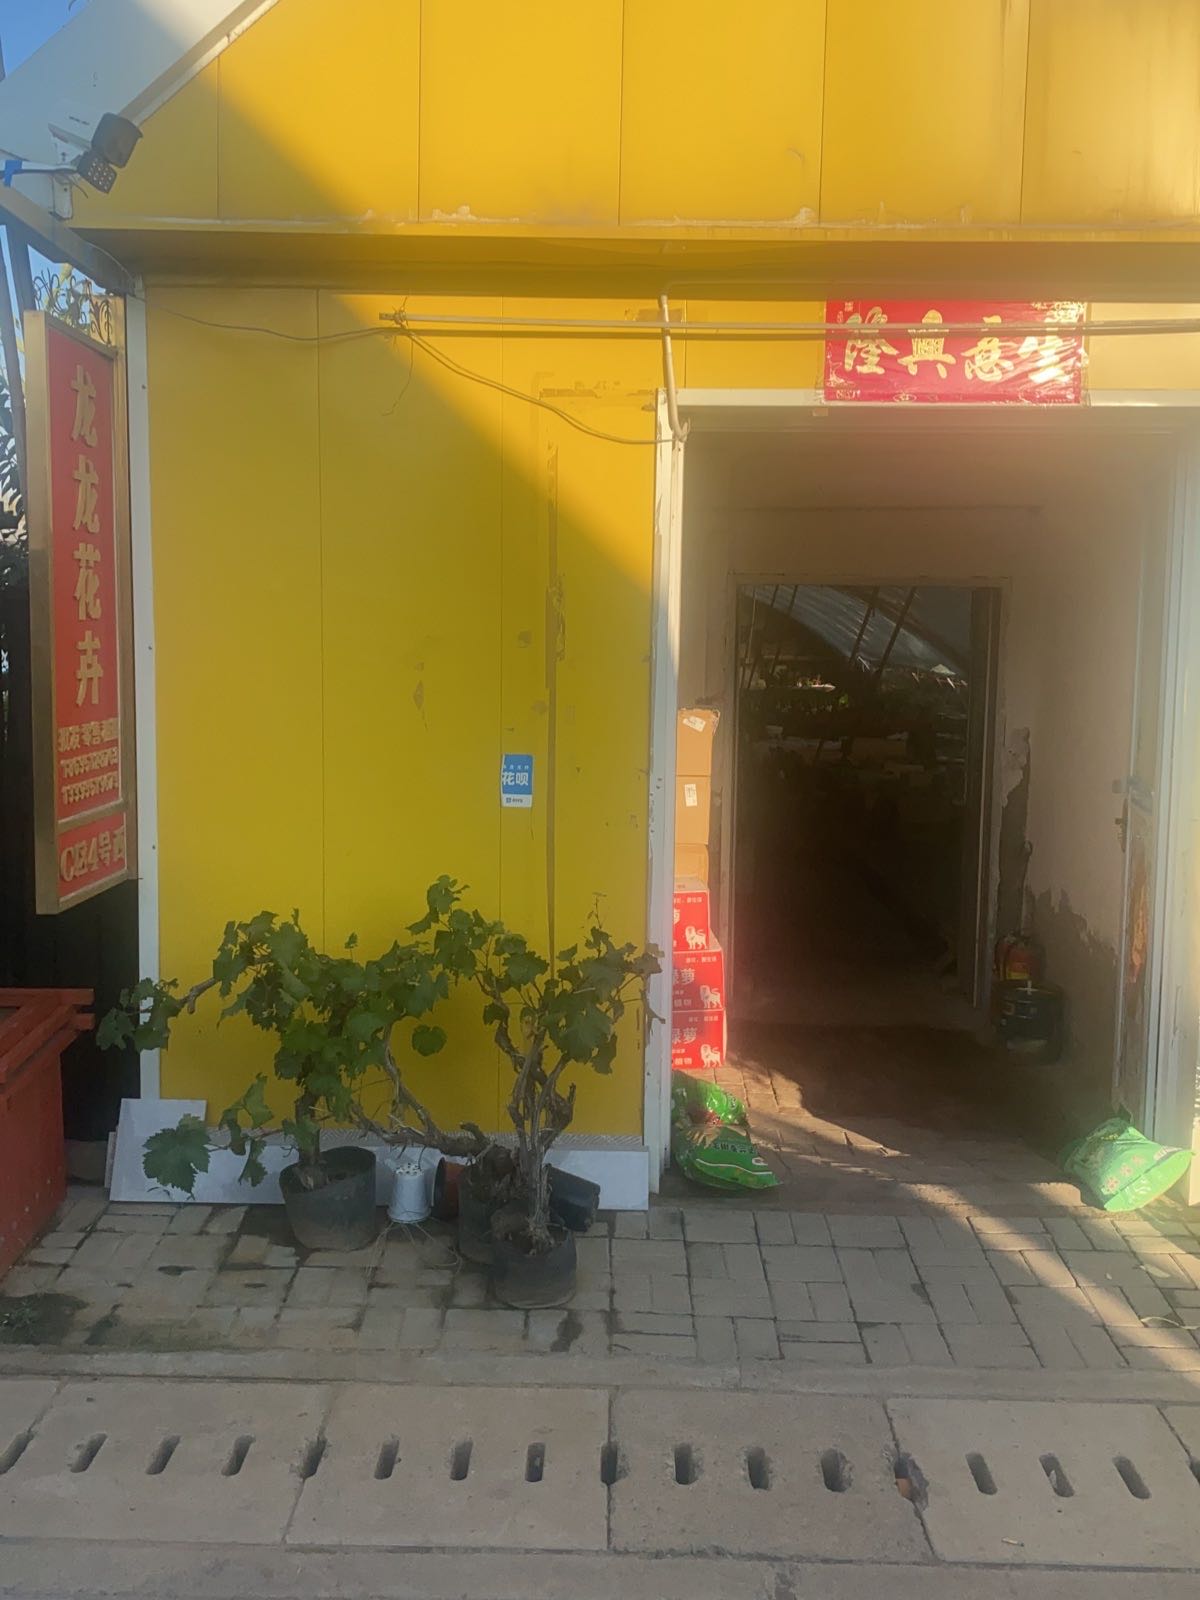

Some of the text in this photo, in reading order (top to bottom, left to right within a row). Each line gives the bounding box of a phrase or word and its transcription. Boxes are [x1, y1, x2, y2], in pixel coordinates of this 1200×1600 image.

[70, 363, 104, 707] 龙龙花卉
[502, 771, 529, 786] 花呗
